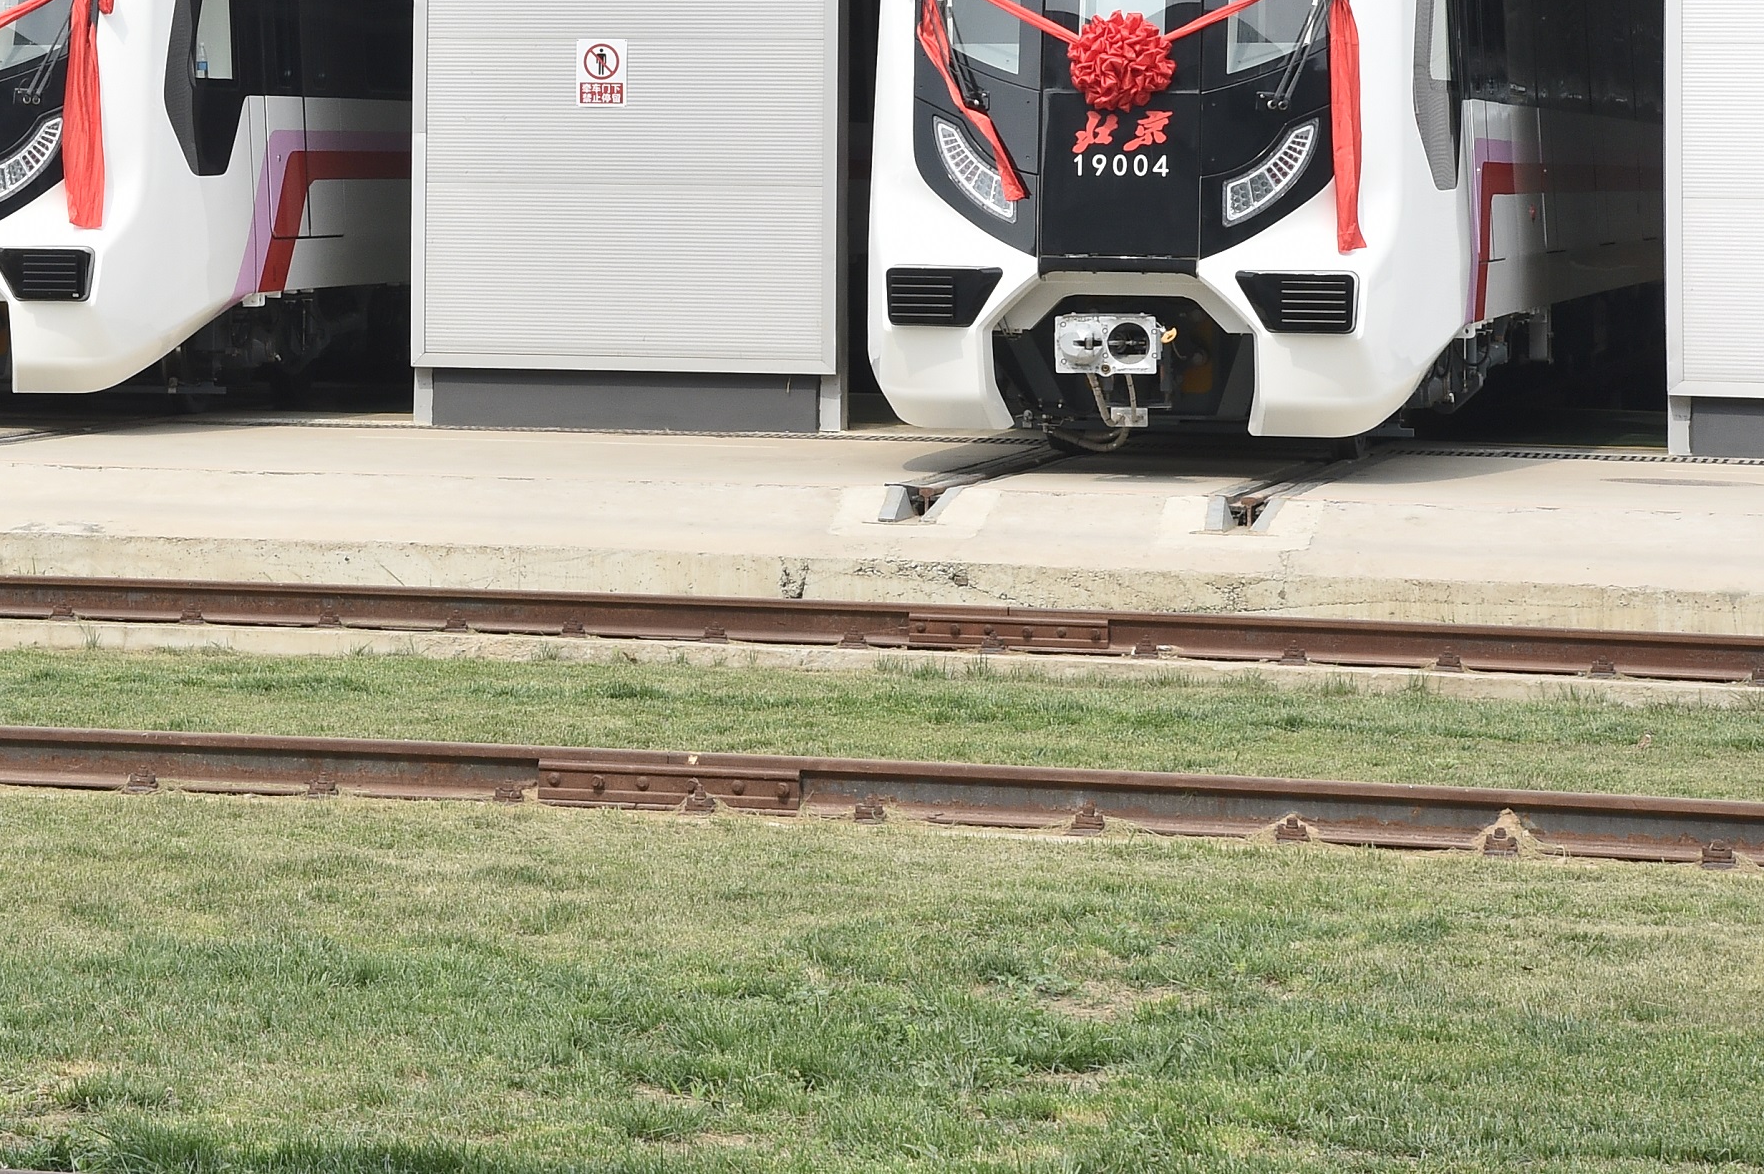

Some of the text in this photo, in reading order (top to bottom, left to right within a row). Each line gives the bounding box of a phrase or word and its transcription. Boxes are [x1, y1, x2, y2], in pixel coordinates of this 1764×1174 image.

[582, 93, 621, 103] 禁止停留
[1072, 111, 1173, 154] 北京
[1073, 154, 1170, 177] 19004
